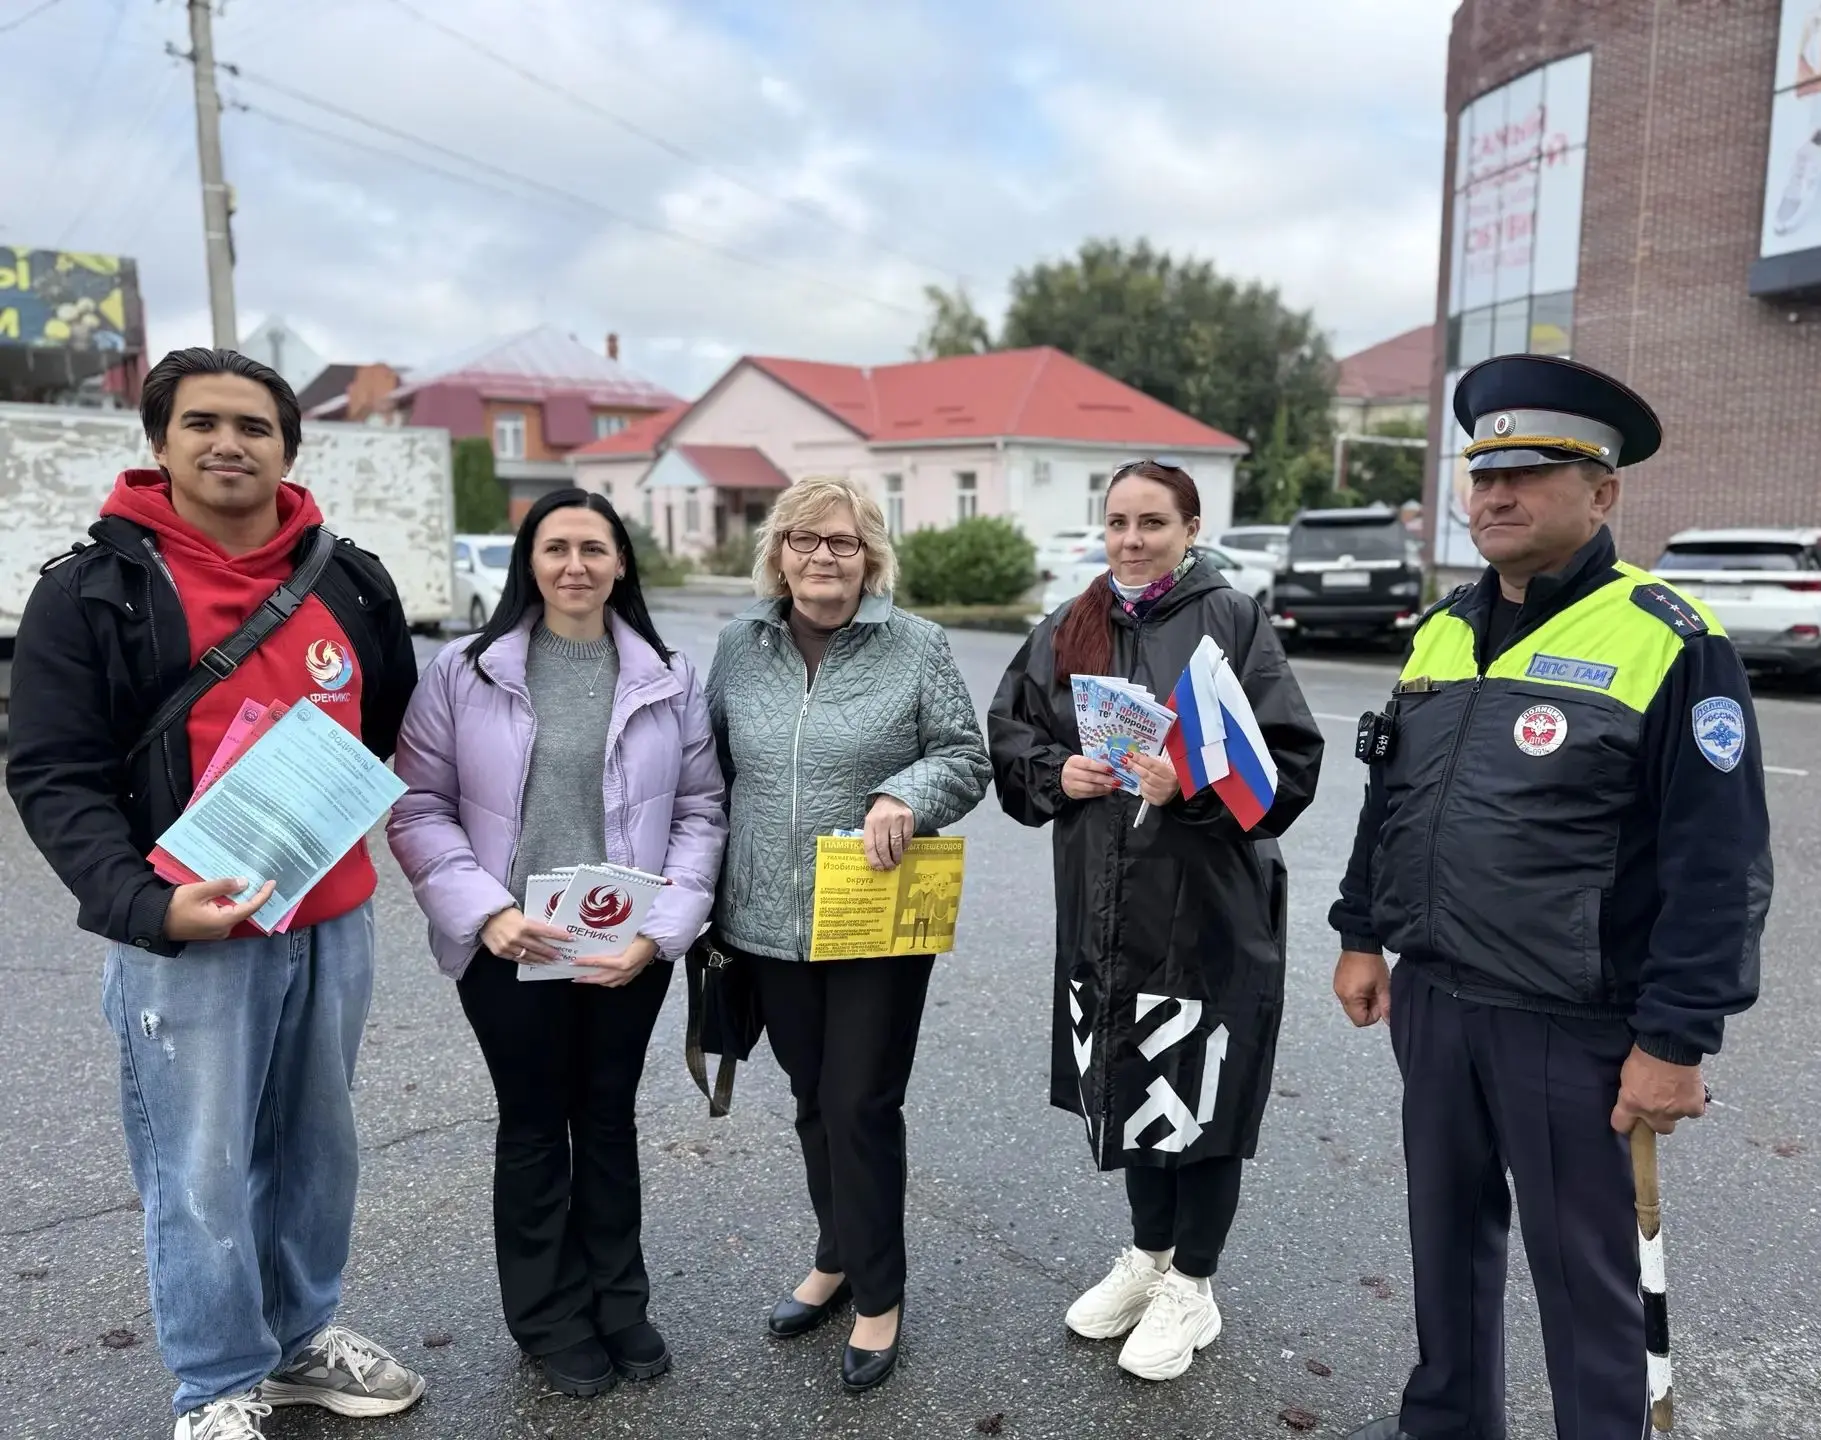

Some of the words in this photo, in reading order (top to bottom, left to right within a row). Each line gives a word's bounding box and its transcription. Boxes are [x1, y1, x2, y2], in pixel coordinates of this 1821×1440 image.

[1535, 660, 1568, 677] ДПС
[1573, 664, 1608, 683] ГАИ
[310, 692, 351, 704] ФЕНИКС
[1120, 706, 1157, 728] против
[1523, 706, 1563, 722] ПОЛИЦИЯ
[1115, 712, 1157, 735] террора!
[1529, 736, 1546, 745] ДПС
[846, 876, 874, 885] округа
[566, 924, 619, 943] ФЕНИКС
